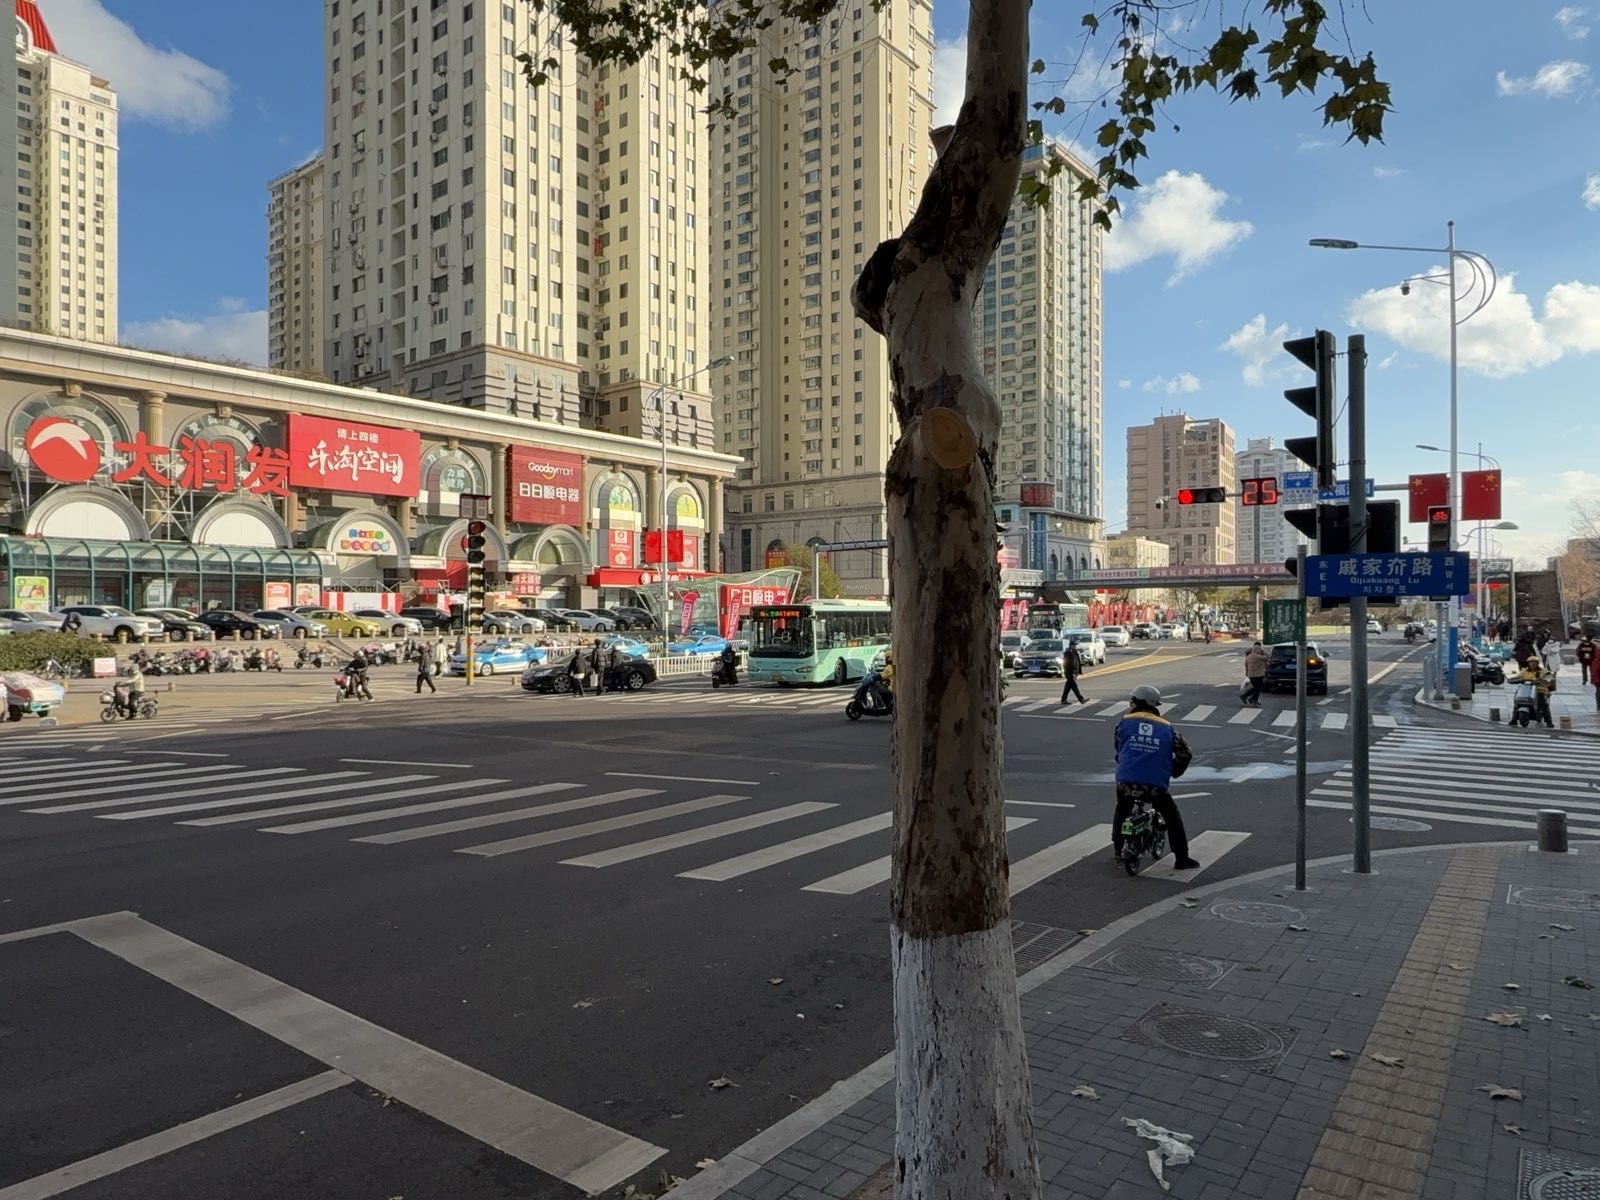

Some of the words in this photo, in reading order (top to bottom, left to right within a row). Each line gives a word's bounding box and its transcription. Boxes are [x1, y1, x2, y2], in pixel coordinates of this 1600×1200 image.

[336, 427, 380, 444] 请上四楼
[112, 431, 290, 497] 大润发
[307, 439, 404, 485] 乐淘空间
[528, 461, 573, 479] Goodaymart
[519, 482, 580, 502] 日日顺电器
[1243, 480, 1276, 504] 25
[1318, 560, 1328, 569] 东
[1338, 557, 1433, 577] 戚家夼路
[1444, 557, 1455, 566] 西
[1319, 572, 1328, 581] E
[1350, 576, 1401, 585] Qijiakuang
[1408, 576, 1420, 584] Lu
[1445, 570, 1454, 578] W
